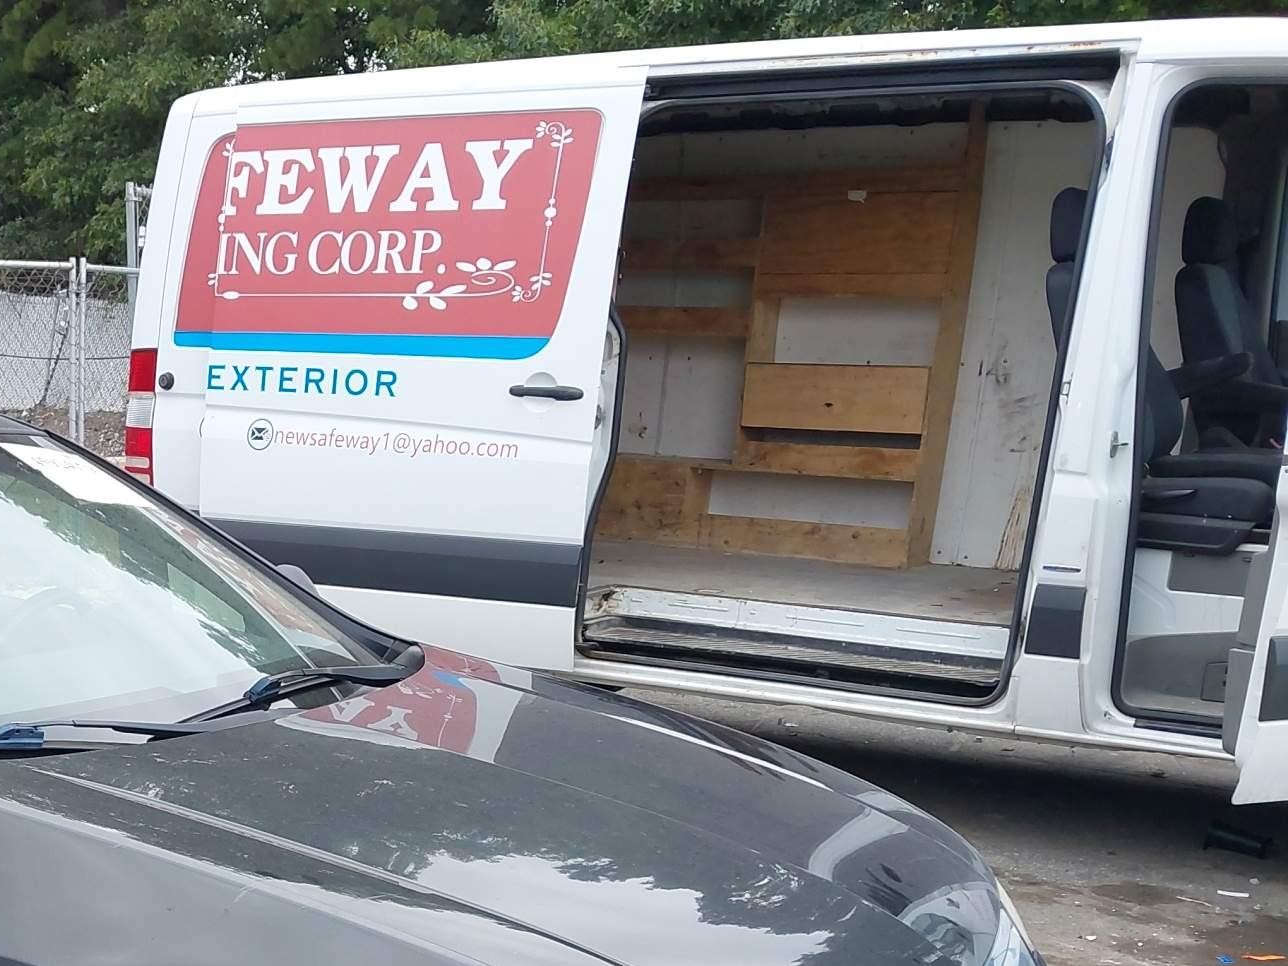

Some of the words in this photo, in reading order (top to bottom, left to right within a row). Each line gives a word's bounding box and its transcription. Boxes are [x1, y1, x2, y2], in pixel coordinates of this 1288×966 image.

[224, 139, 534, 217] FEWAY
[217, 231, 298, 275] ING
[307, 230, 447, 275] CORP.
[206, 364, 399, 398] EXTERIOR
[273, 427, 520, 459] newsafeway1@yahoo.com
